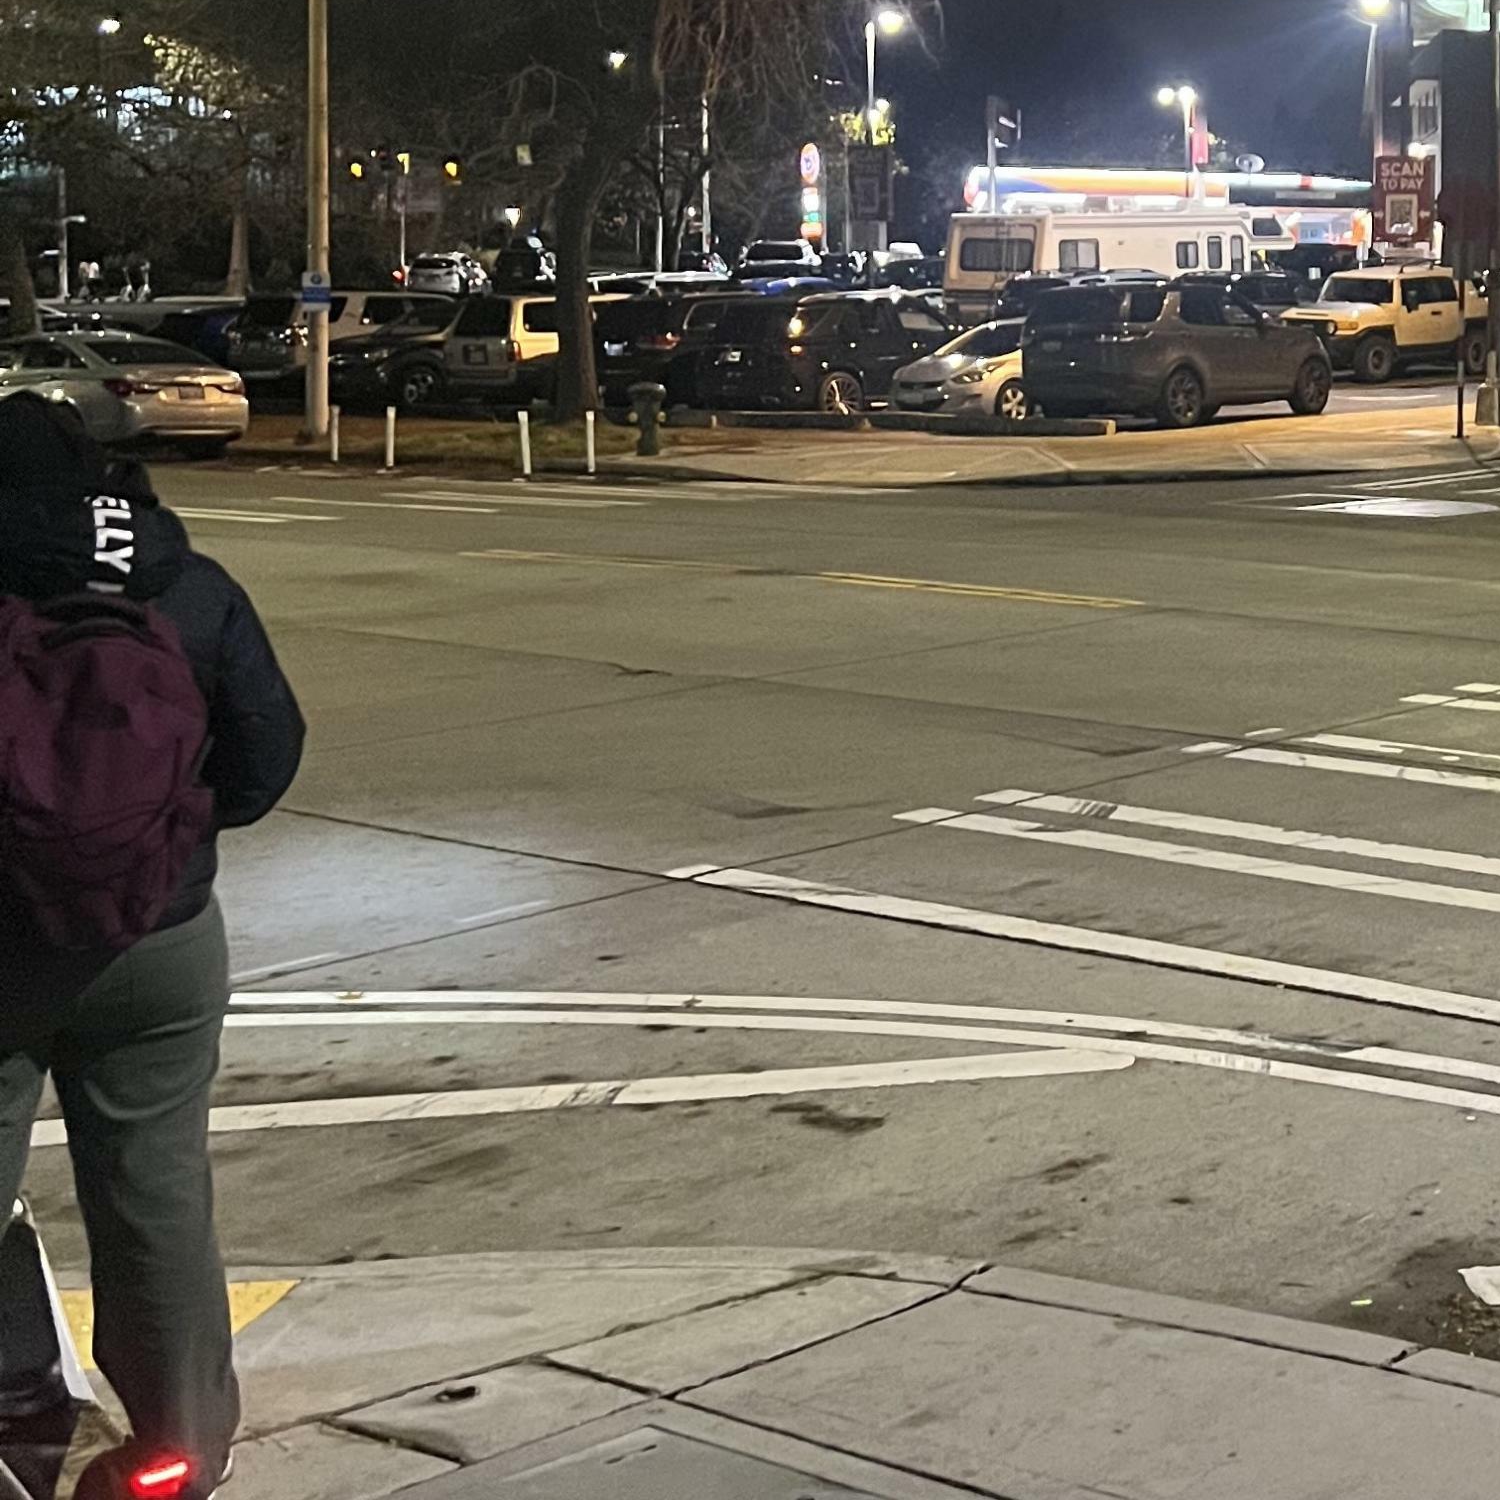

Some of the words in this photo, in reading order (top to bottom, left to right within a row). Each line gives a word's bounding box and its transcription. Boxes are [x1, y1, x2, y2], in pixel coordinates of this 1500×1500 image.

[1381, 162, 1425, 177] SCAN
[1381, 178, 1398, 191] TO
[1400, 178, 1425, 191] PAY
[91, 495, 134, 574] ELLY
